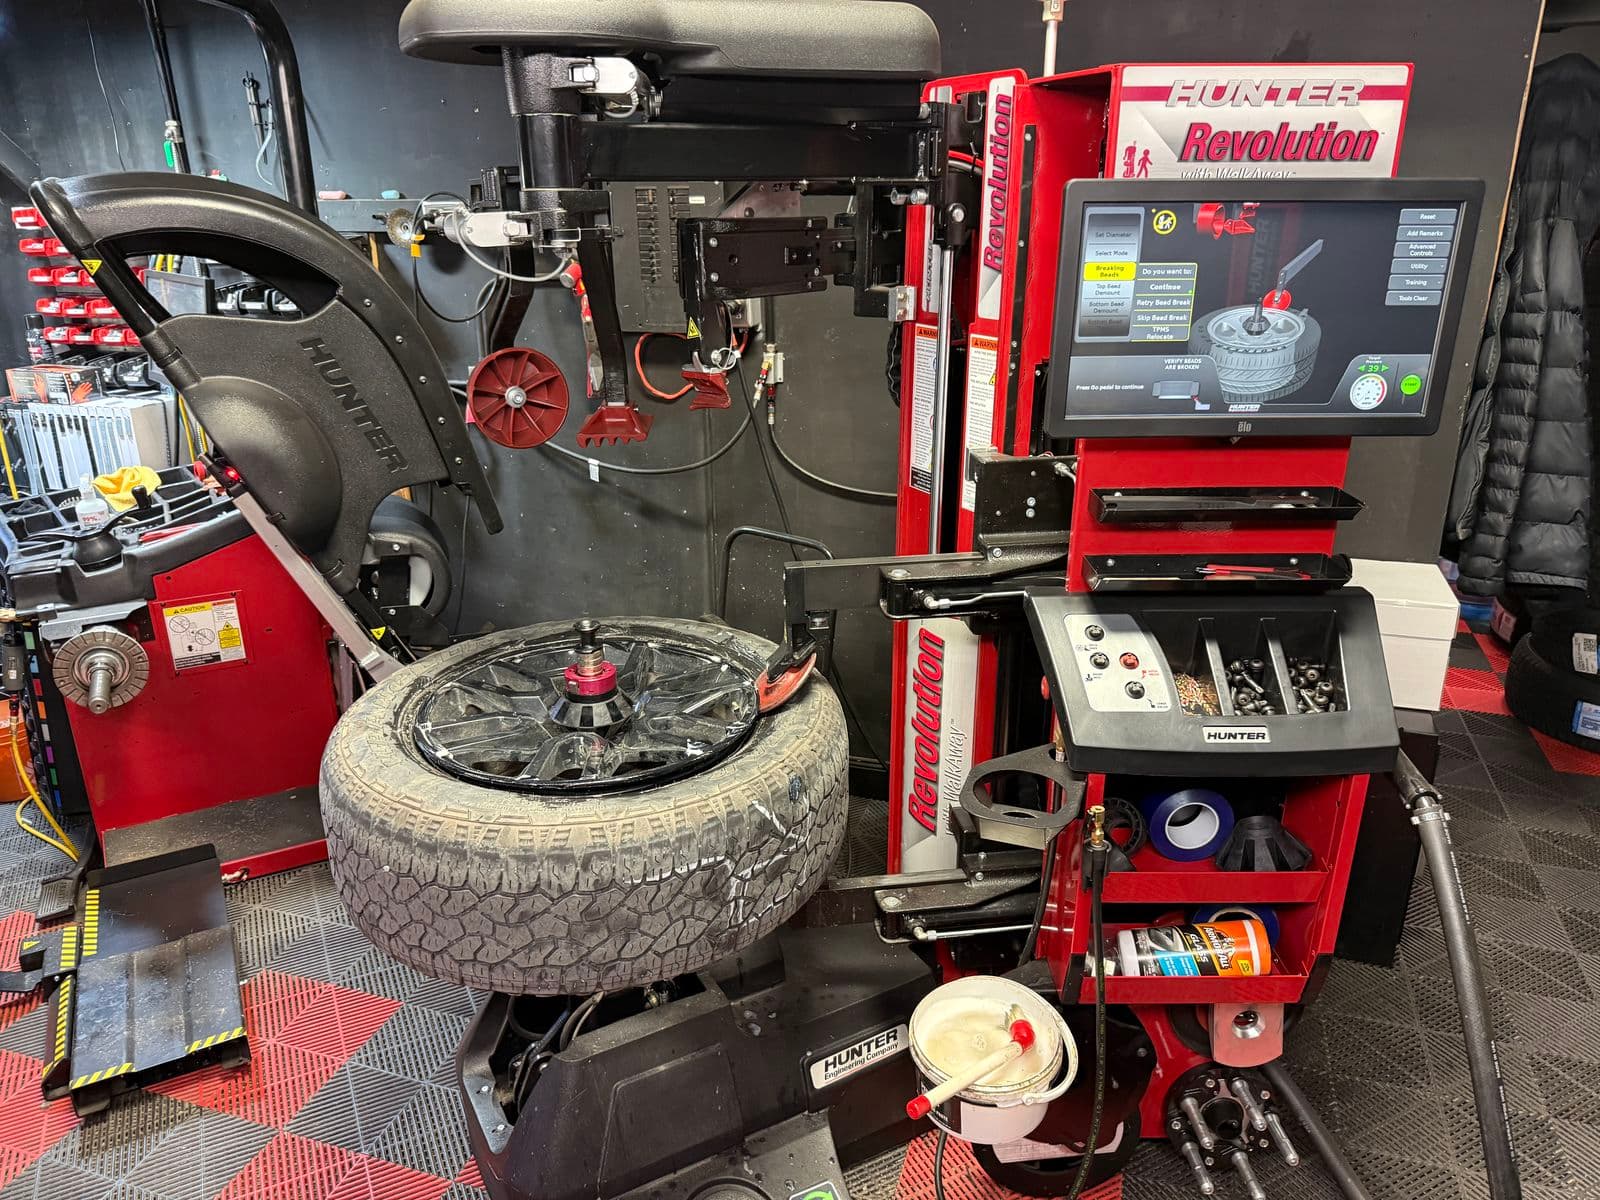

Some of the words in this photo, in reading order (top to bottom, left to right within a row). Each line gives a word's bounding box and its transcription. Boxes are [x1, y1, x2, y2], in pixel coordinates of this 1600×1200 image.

[1165, 79, 1365, 108] HUNTER
[1177, 121, 1380, 162] Revolution
[983, 93, 1012, 272] Revolution
[298, 338, 408, 474] HUNTER
[908, 627, 945, 836] Revolution
[943, 723, 968, 802] WalkAway
[1190, 933, 1208, 963] GLASS
[824, 1028, 898, 1072] HUNTER
[824, 1057, 865, 1080] Engineering
[866, 1042, 899, 1060] Company
